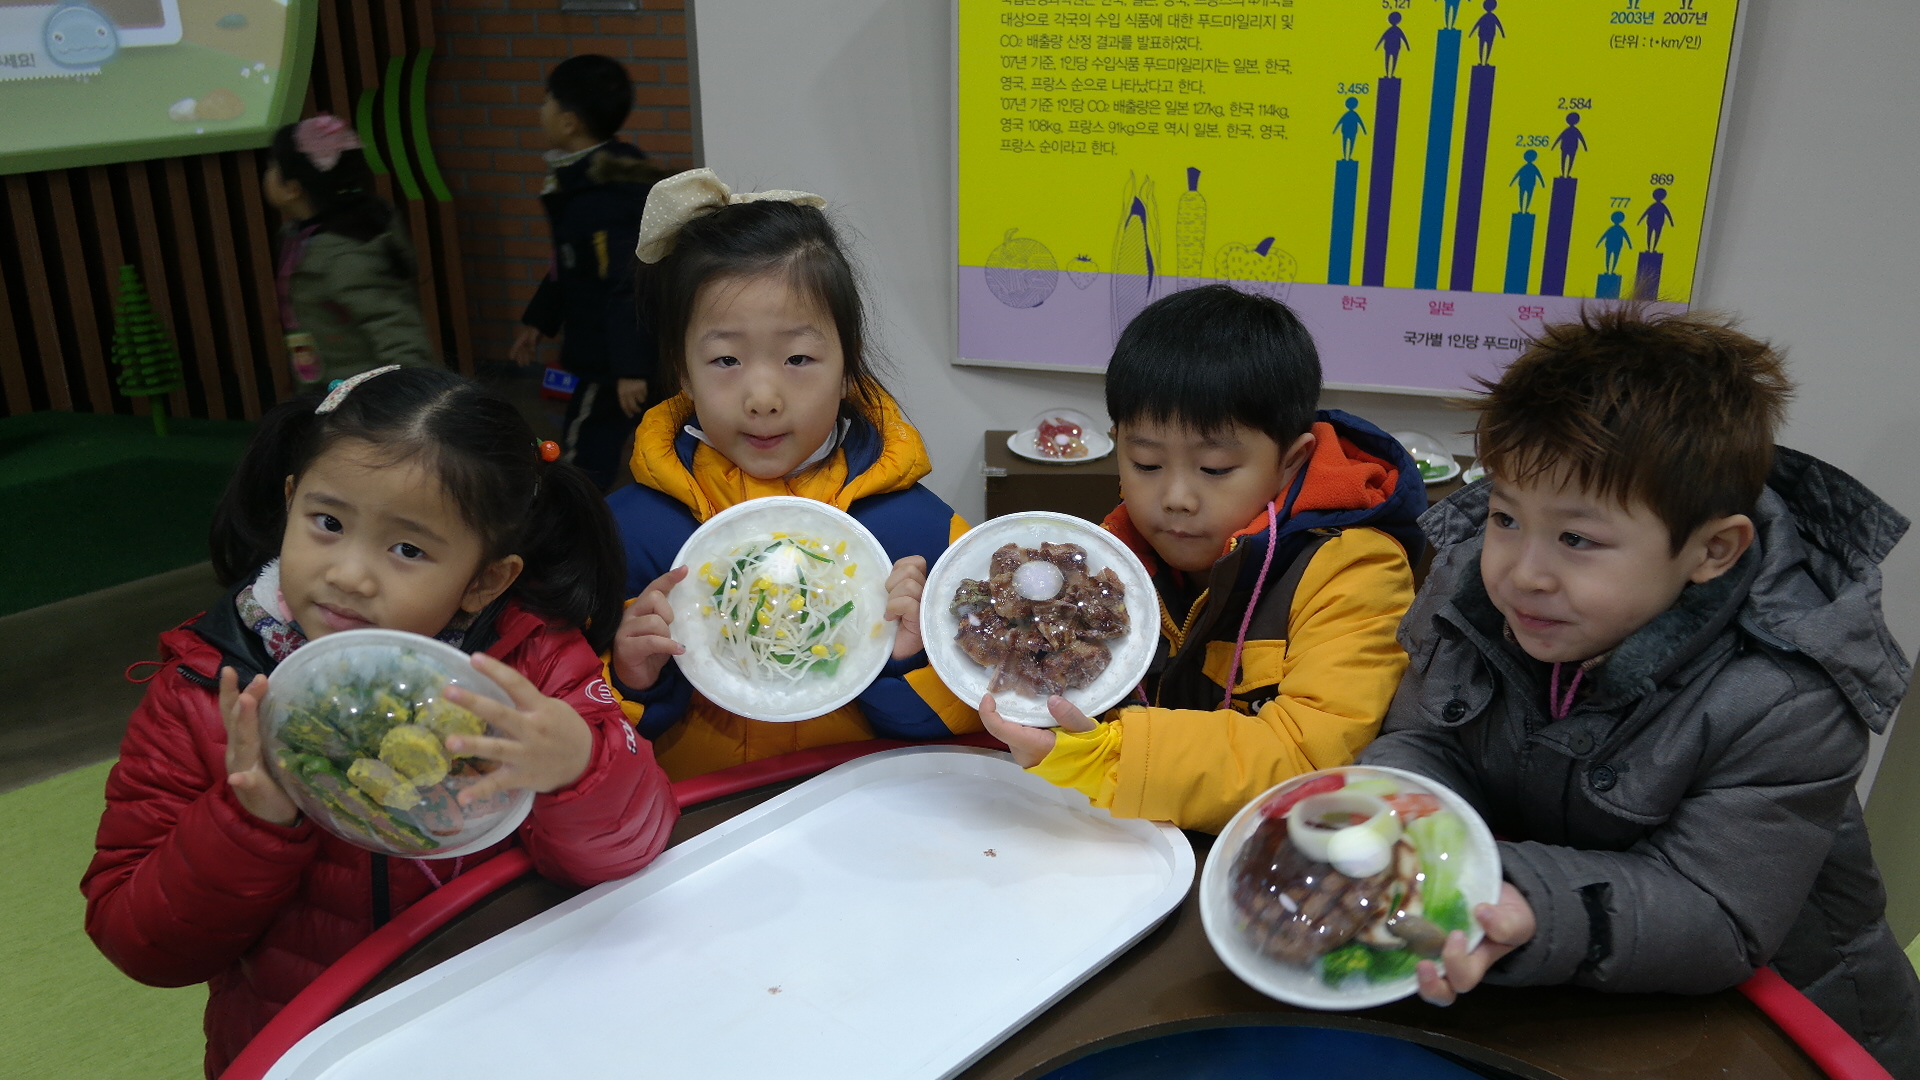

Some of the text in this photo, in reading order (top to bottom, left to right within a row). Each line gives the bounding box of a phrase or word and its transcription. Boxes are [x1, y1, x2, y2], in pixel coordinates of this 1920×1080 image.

[1000, 13, 1293, 30] 대상으로 각국의 수입 식품에 대한 푸드마일리지 및
[1610, 11, 1708, 25] 2003년 2007년
[1026, 34, 1063, 49] 배출량
[1066, 35, 1091, 49] 산정
[1096, 35, 1132, 50] 결과를
[1610, 34, 1639, 49] (단위
[1060, 56, 1088, 71] 1인당
[1091, 57, 1139, 71] 수입식품
[1143, 58, 1230, 73] 푸드마일리지는
[1030, 77, 1067, 91] 프랑스
[1070, 78, 1107, 91] 순으로
[1111, 79, 1173, 93] 나타났다고
[1337, 83, 1369, 94] 3,456
[1030, 98, 1053, 112] 기준
[1056, 99, 1084, 113] 1인당
[1113, 100, 1161, 115] 배출량은
[1164, 101, 1189, 115] 일본
[1229, 102, 1254, 117] 한국
[1558, 98, 1592, 110] 2,584
[999, 118, 1023, 132] 영국
[1068, 120, 1104, 134] 프랑스
[1163, 122, 1188, 136] 역시
[999, 139, 1035, 153] 프랑스
[1039, 140, 1086, 154] 순이라고
[1516, 135, 1549, 147] 2,356
[1650, 174, 1674, 185] 869
[1610, 197, 1631, 208] 777
[1342, 296, 1367, 311] 한국
[1429, 301, 1454, 316] 일본
[1518, 306, 1544, 321] 영국
[1404, 331, 1443, 347] 국가별
[1448, 334, 1479, 349] 1인당
